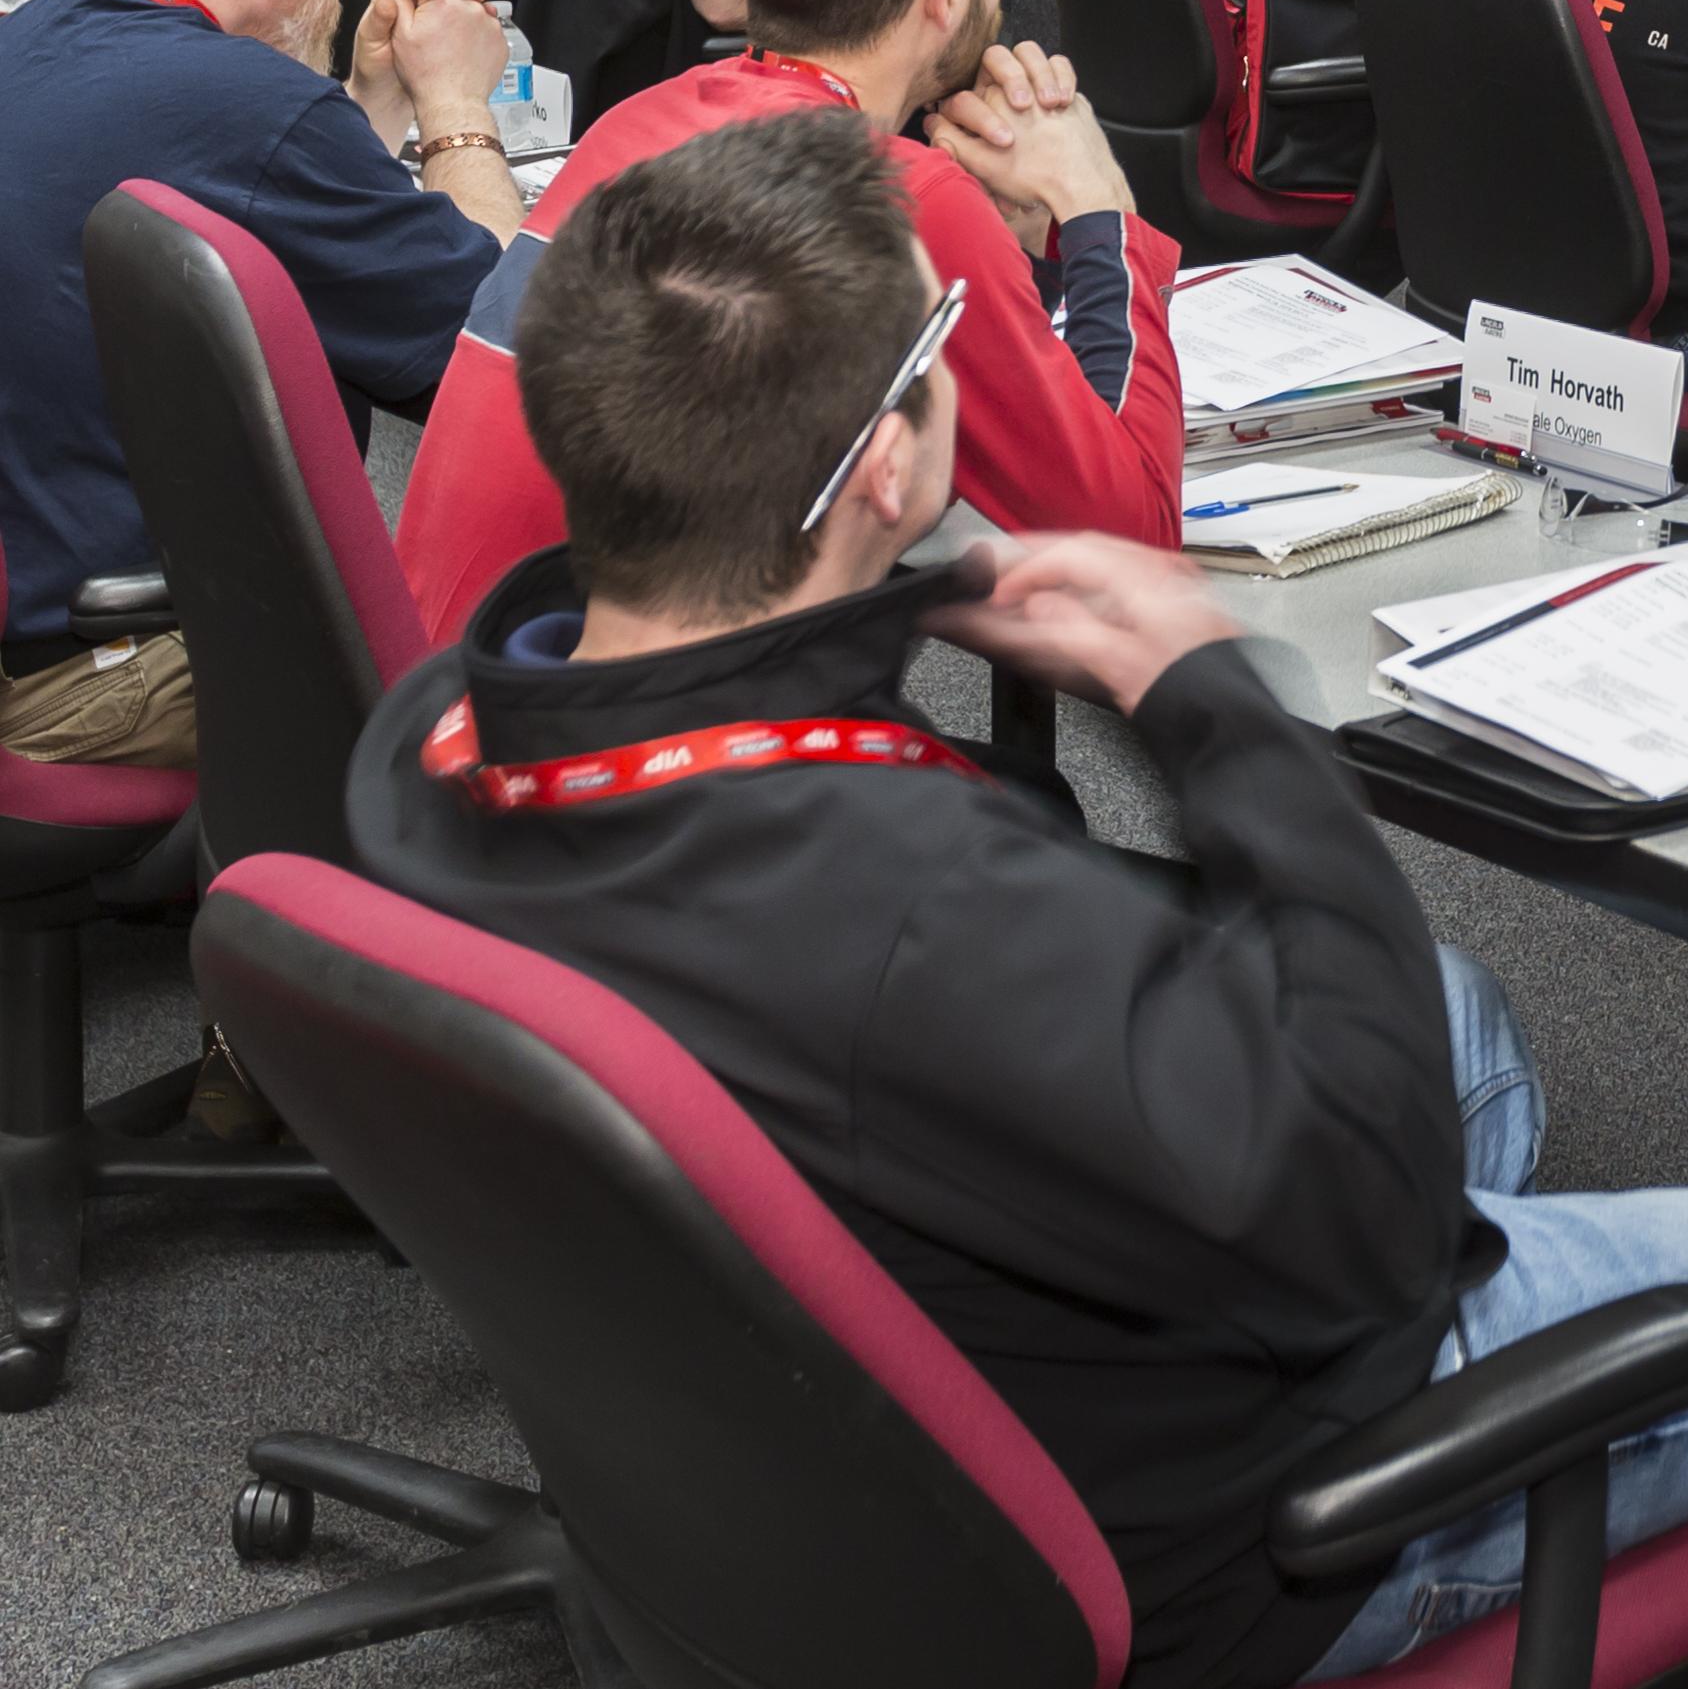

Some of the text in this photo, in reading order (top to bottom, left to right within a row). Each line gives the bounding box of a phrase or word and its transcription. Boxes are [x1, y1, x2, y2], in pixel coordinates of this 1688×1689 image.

[1648, 30, 1669, 50] CA
[1507, 356, 1624, 412] Tim Horvath
[1533, 412, 1551, 431] ale
[1554, 416, 1602, 447] Oxygen
[643, 744, 693, 774] VIP
